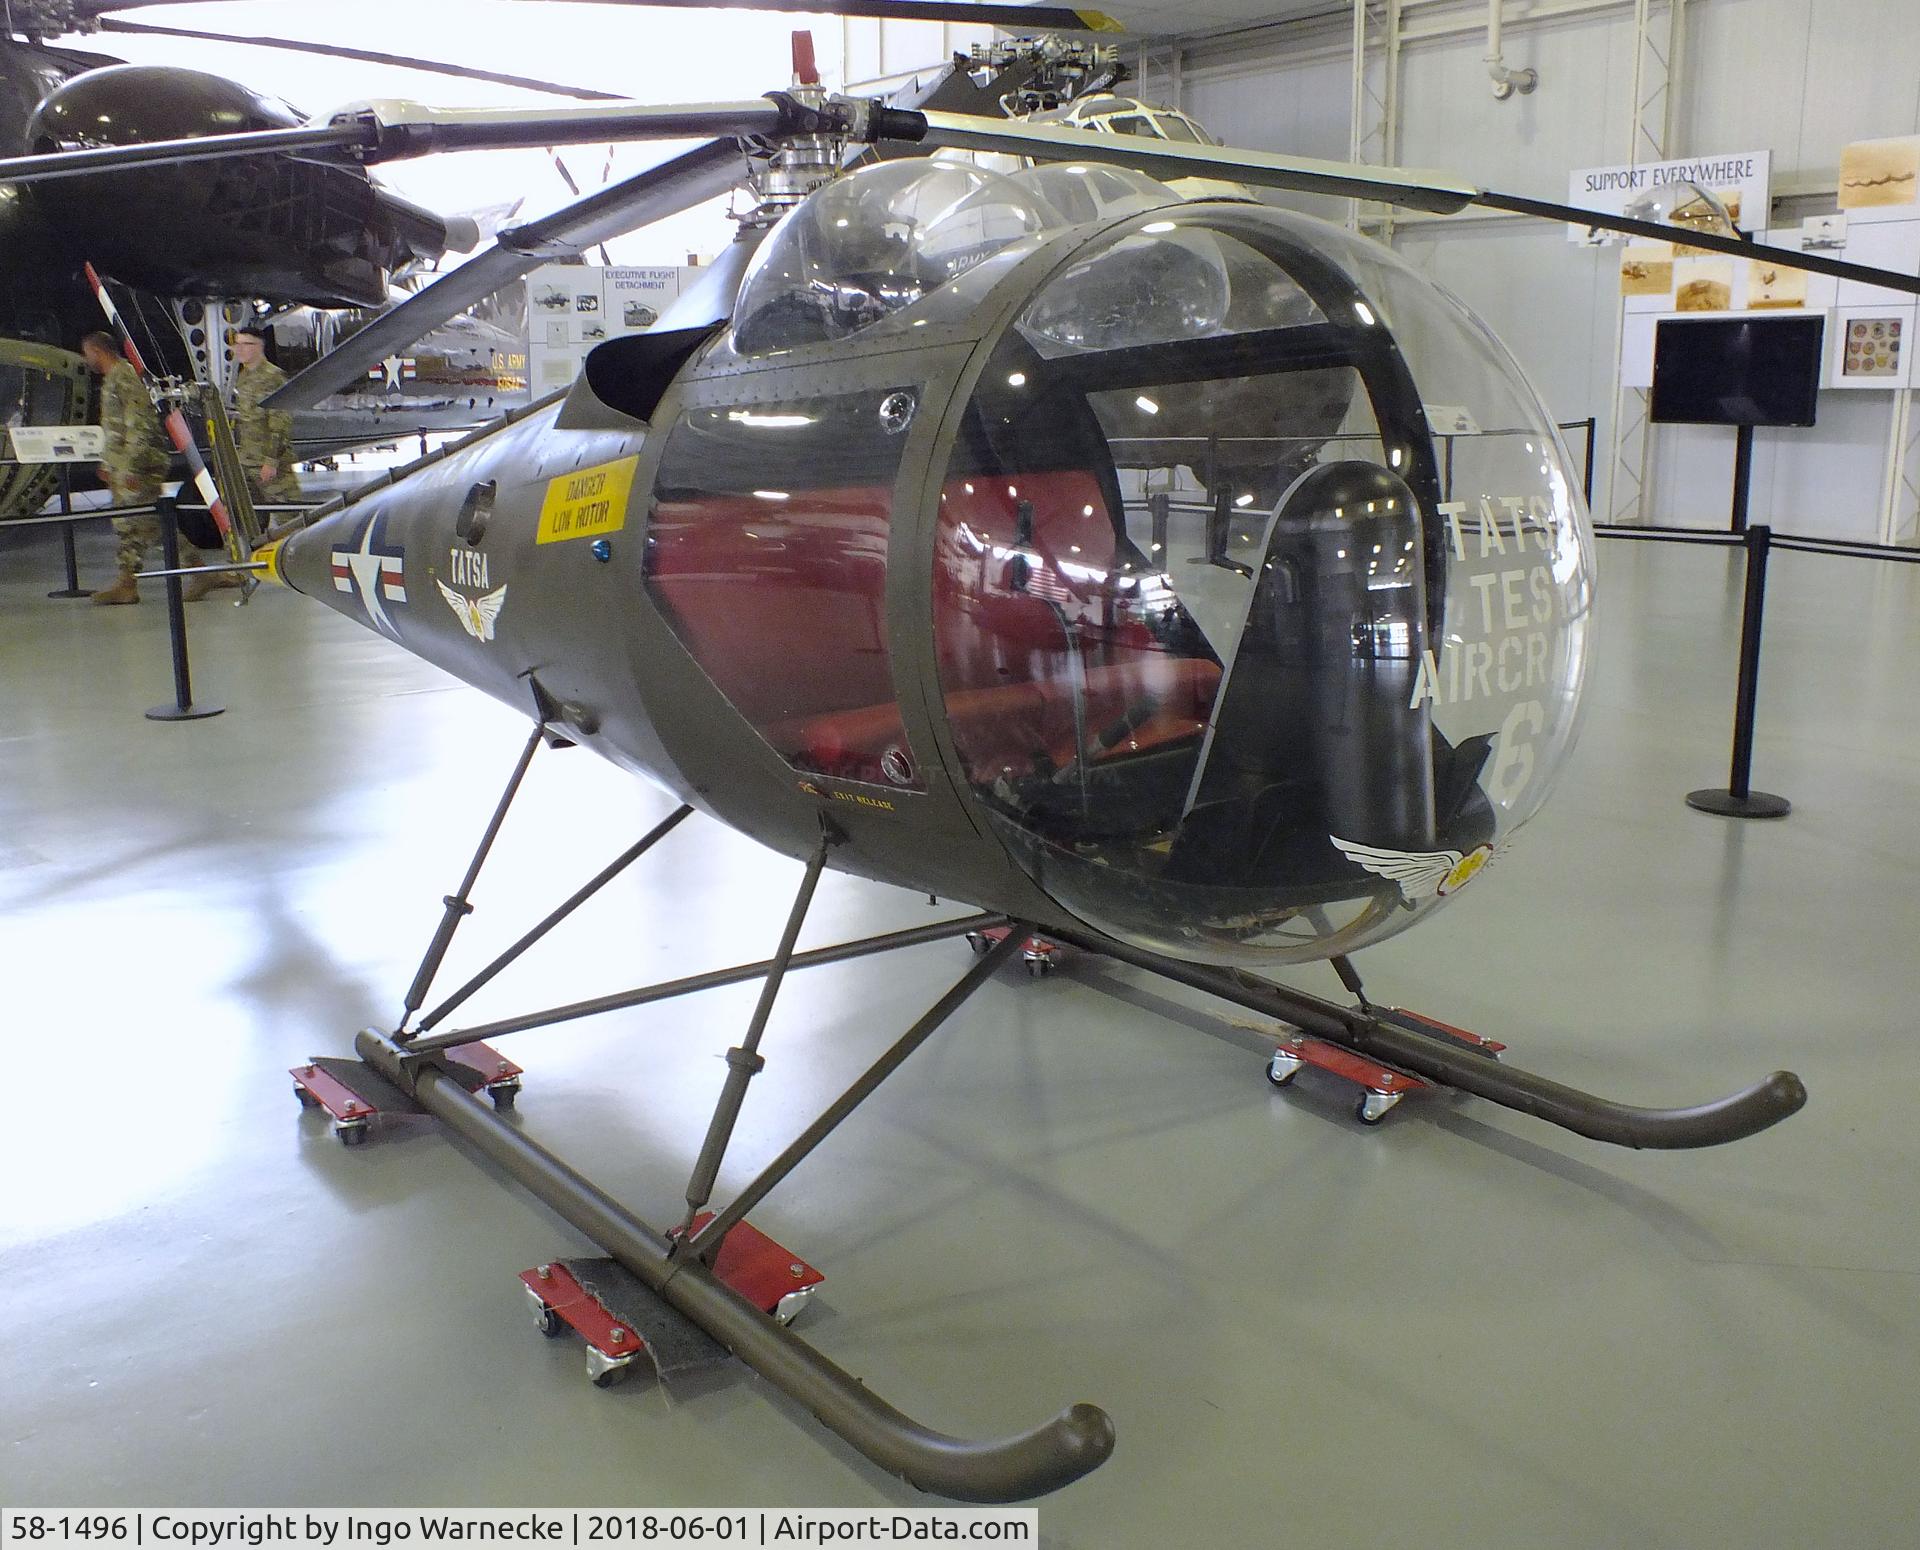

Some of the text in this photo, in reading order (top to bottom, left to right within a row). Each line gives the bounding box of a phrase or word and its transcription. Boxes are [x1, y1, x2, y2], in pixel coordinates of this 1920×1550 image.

[1585, 159, 1753, 193] SUPPORT EVERYWHERE
[605, 270, 675, 280] EXECUTIVE FLIGHT
[615, 281, 666, 290] DETACHMENT
[507, 353, 527, 370] ARMY
[565, 472, 607, 502] DANGER
[551, 499, 611, 535] LOW ROTOR
[451, 548, 490, 589] TATSA
[1469, 565, 1567, 634] TES
[1409, 631, 1558, 710] AIRCR
[1486, 700, 1545, 811] 6
[856, 795, 896, 812] RELEASE
